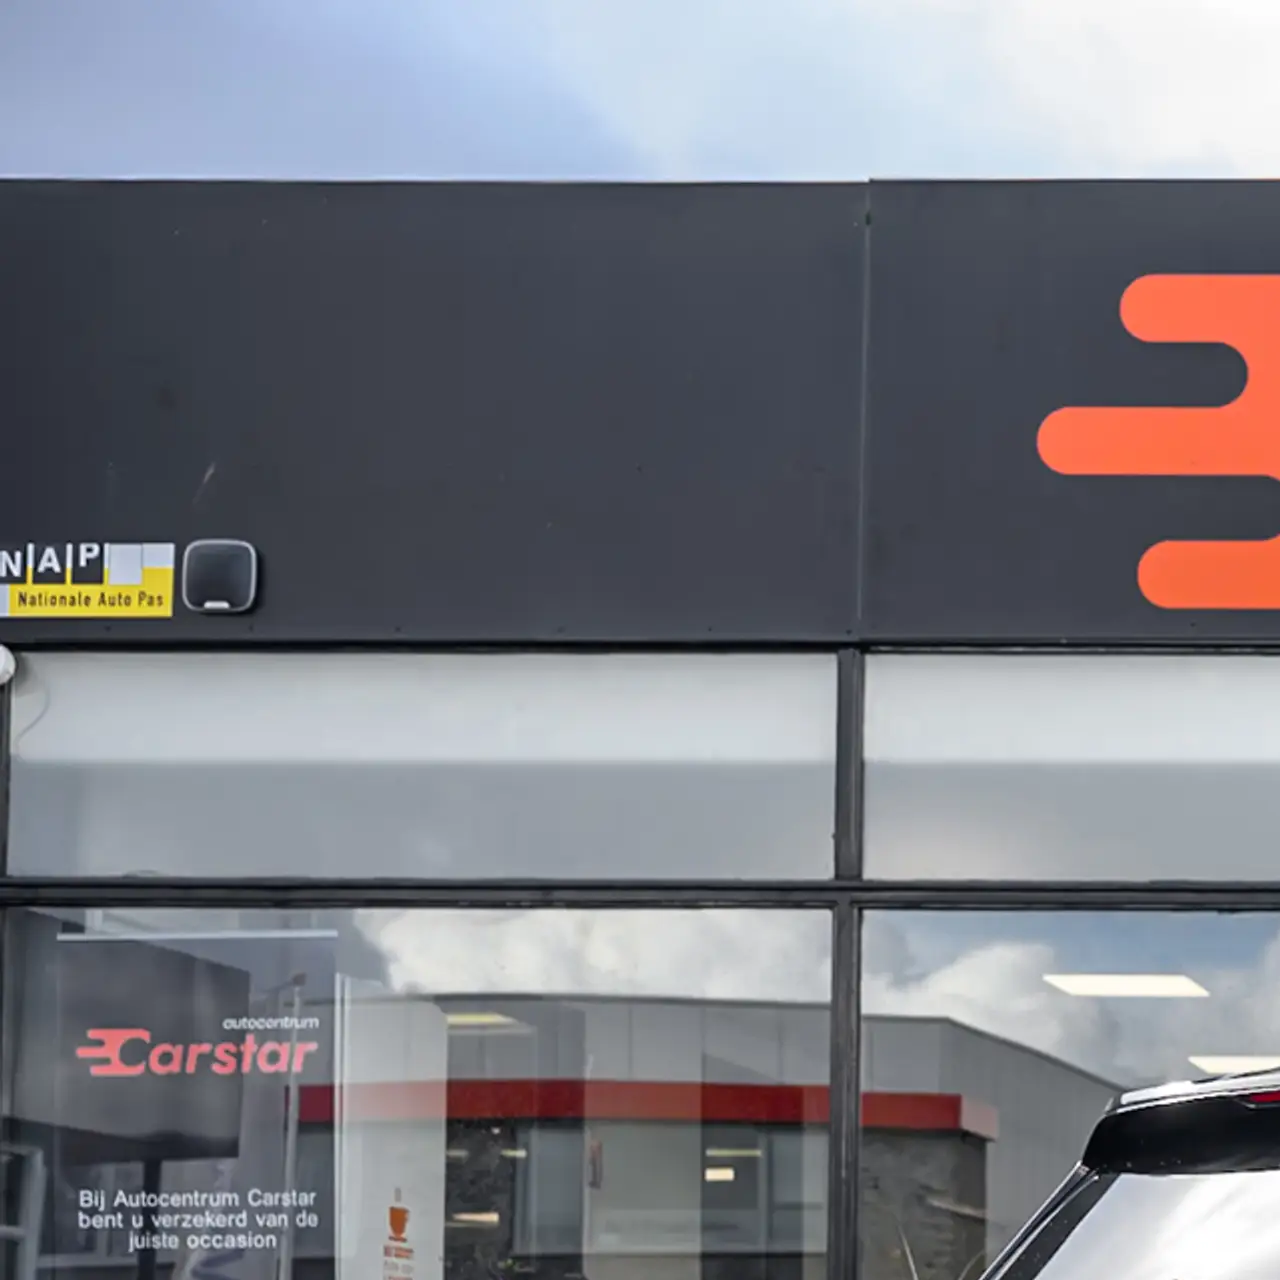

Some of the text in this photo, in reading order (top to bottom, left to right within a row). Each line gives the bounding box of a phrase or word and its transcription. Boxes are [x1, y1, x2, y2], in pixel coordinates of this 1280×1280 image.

[17, 590, 164, 607] Nationale Auto Pas
[222, 1016, 320, 1030] autocentrum
[76, 1028, 319, 1076] Carstar
[79, 1188, 317, 1211] Bij Autocentrum Carstar
[78, 1210, 319, 1229] bent u verzekerd van de
[128, 1231, 278, 1252] juiste occasion
